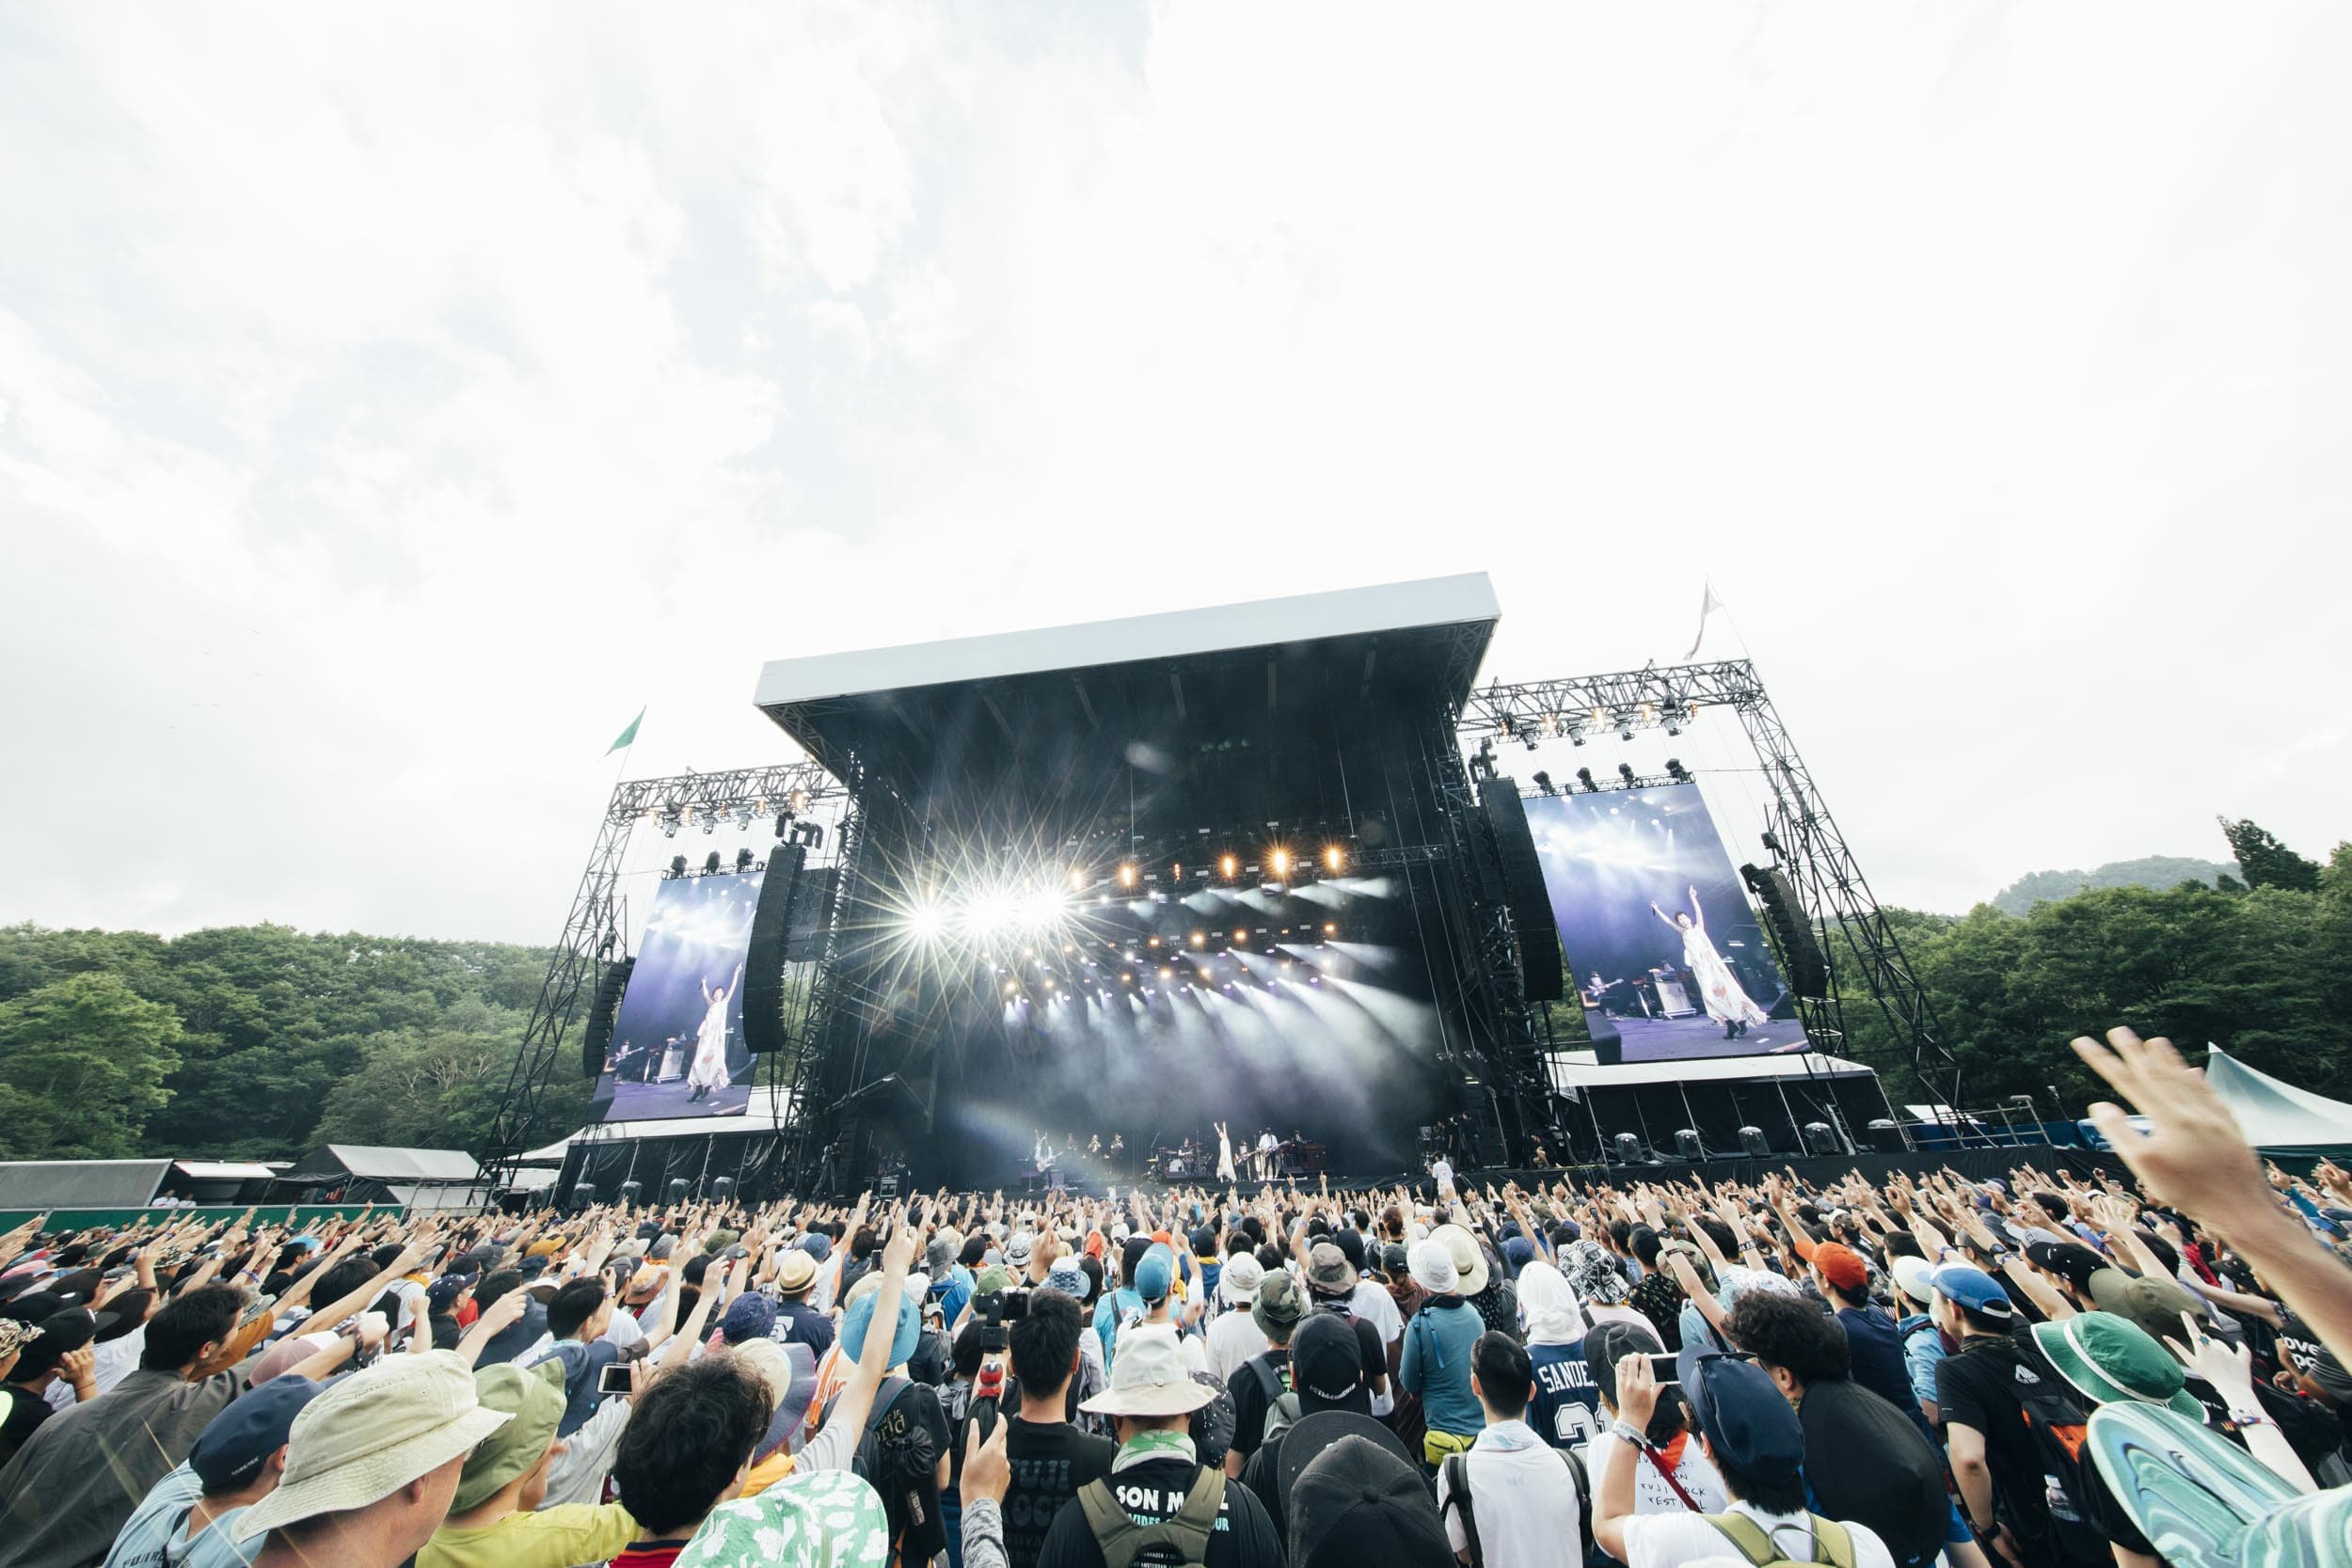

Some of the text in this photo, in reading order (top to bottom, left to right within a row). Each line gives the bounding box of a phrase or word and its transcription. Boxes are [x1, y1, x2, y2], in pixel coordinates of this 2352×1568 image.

[1538, 1360, 1599, 1394] SANDE
[873, 1413, 907, 1443] orld
[1653, 1471, 1688, 1481] JAAN
[1116, 1485, 1159, 1511] SON
[1684, 1486, 1706, 1497] OCK
[1648, 1496, 1708, 1510] FESTIL
